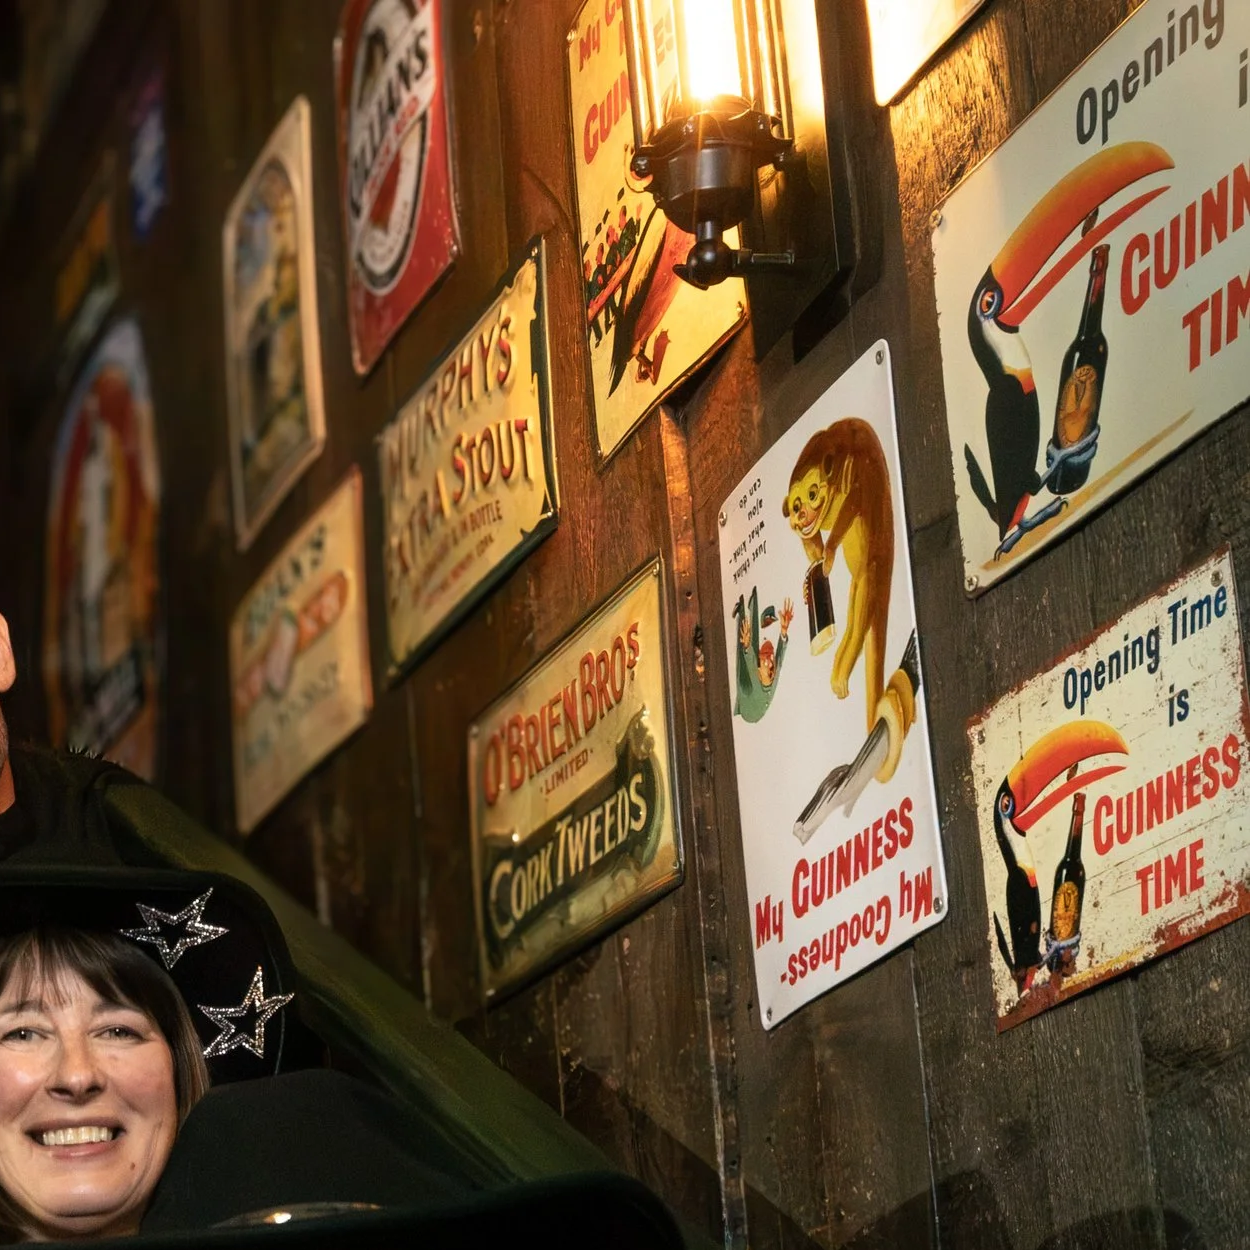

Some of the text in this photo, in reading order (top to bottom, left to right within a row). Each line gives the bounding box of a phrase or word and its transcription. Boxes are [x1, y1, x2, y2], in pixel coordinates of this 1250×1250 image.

[579, 17, 600, 72] My
[1076, 0, 1225, 146] Opening
[452, 418, 533, 505] STOUT
[469, 499, 503, 533] BOTTLE
[738, 494, 748, 509] do
[748, 520, 765, 543] what
[732, 558, 750, 585] think
[1063, 585, 1227, 716] Opening Time
[484, 678, 582, 807] O'BRIEN
[1168, 684, 1190, 727] is
[1093, 733, 1240, 857] GUINNESS
[489, 772, 648, 940] CORK TWEEDS
[755, 797, 913, 949] My GUINNESS
[899, 865, 932, 924] My
[1136, 838, 1205, 916] TIME
